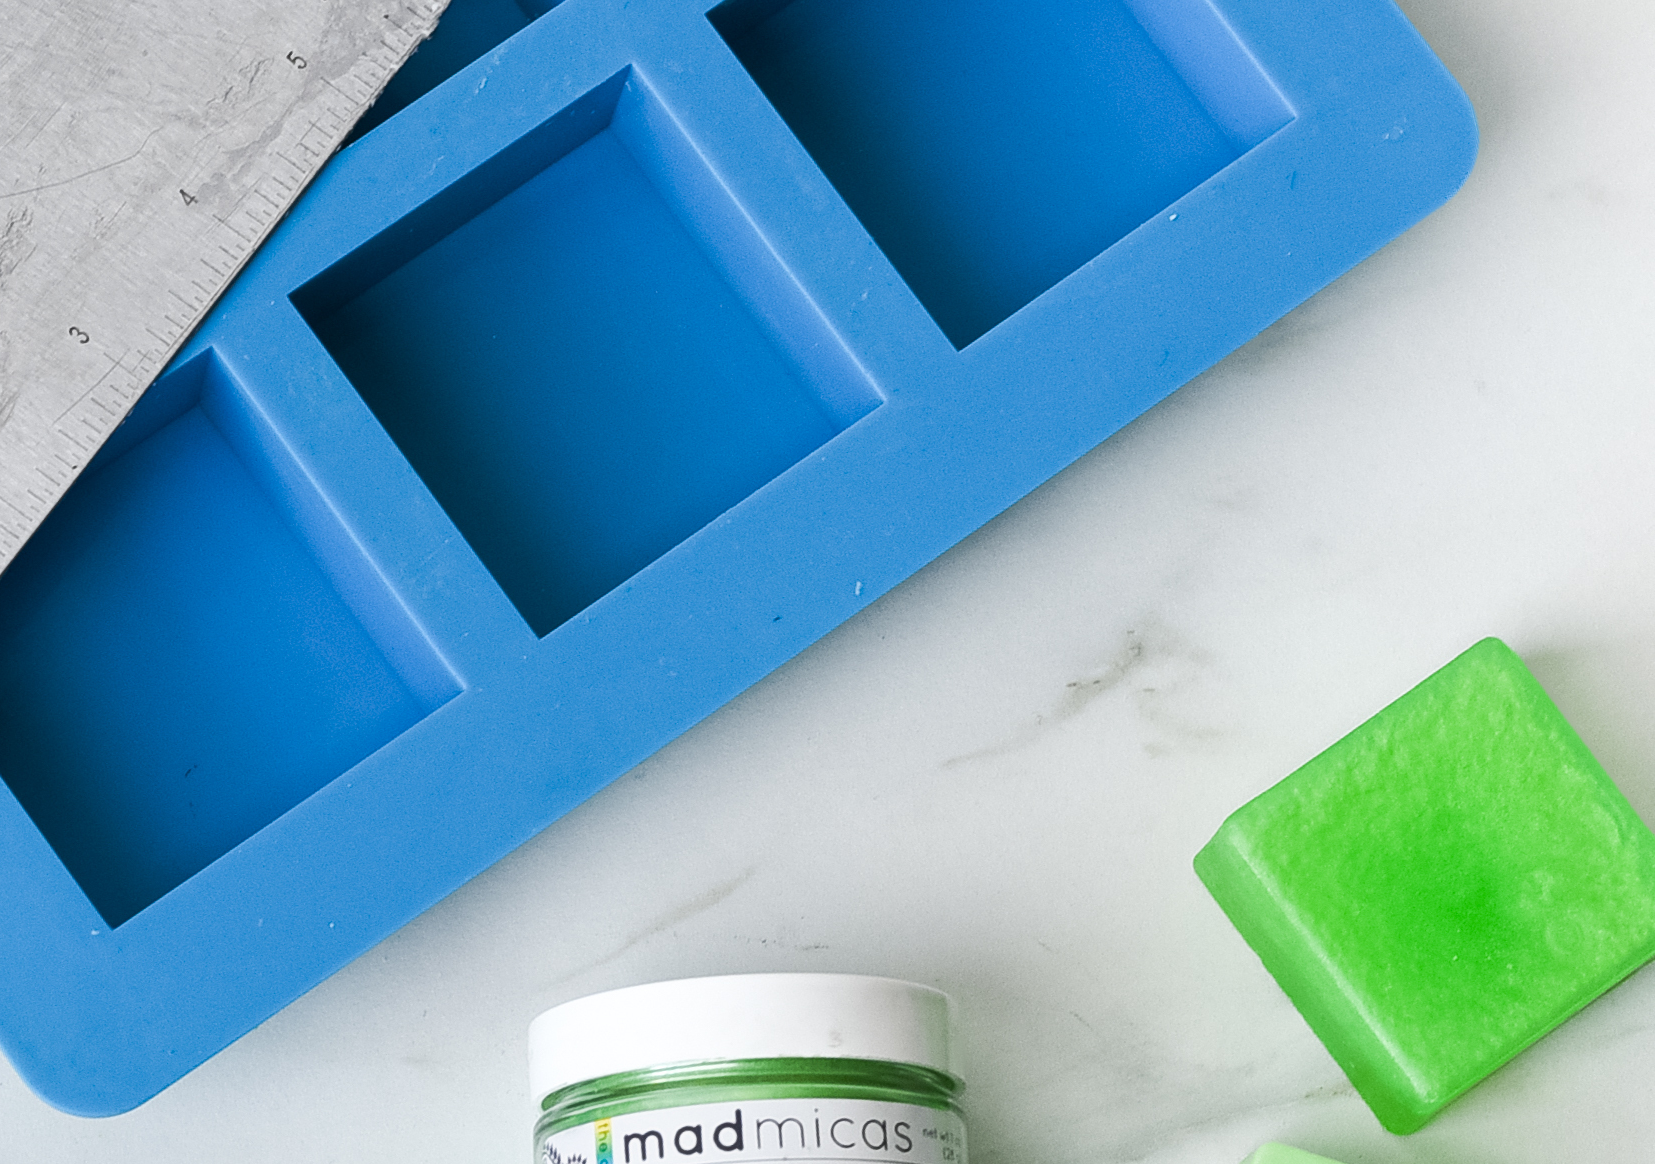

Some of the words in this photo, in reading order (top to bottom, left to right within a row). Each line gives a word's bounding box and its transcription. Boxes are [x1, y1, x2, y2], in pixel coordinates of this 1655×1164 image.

[286, 50, 307, 69] 5
[179, 189, 198, 206] 4
[68, 326, 89, 344] 3
[598, 1122, 609, 1153] the
[624, 1108, 913, 1164] madmicas
